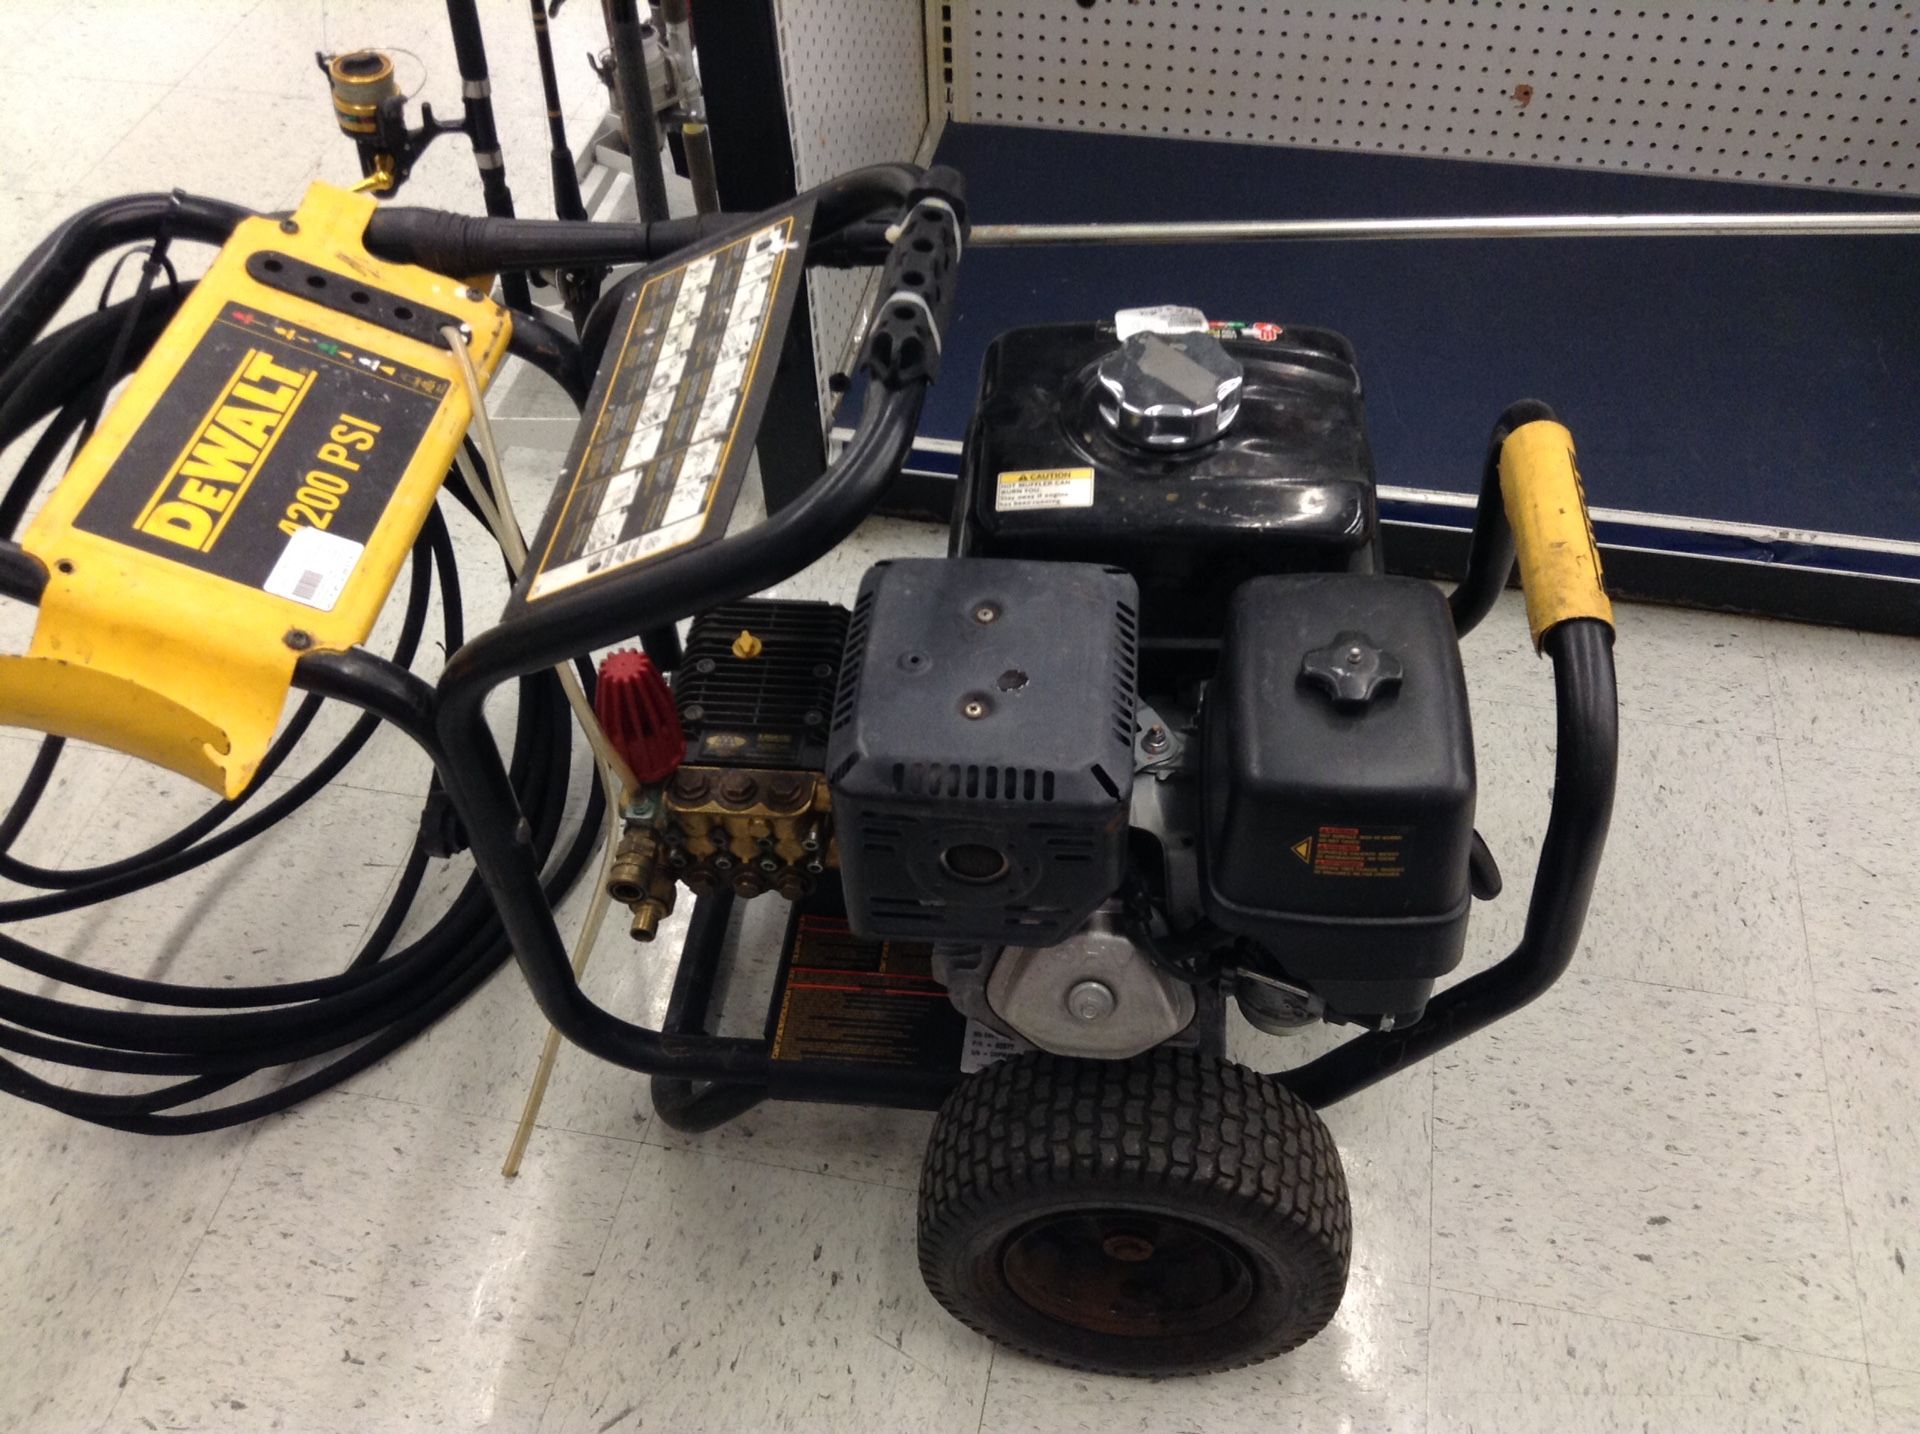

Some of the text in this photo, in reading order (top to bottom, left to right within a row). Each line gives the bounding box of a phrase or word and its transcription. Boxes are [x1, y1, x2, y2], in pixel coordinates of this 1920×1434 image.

[141, 351, 307, 550] DEWALT
[317, 413, 382, 472] PSI
[1030, 472, 1072, 481] CAUTION
